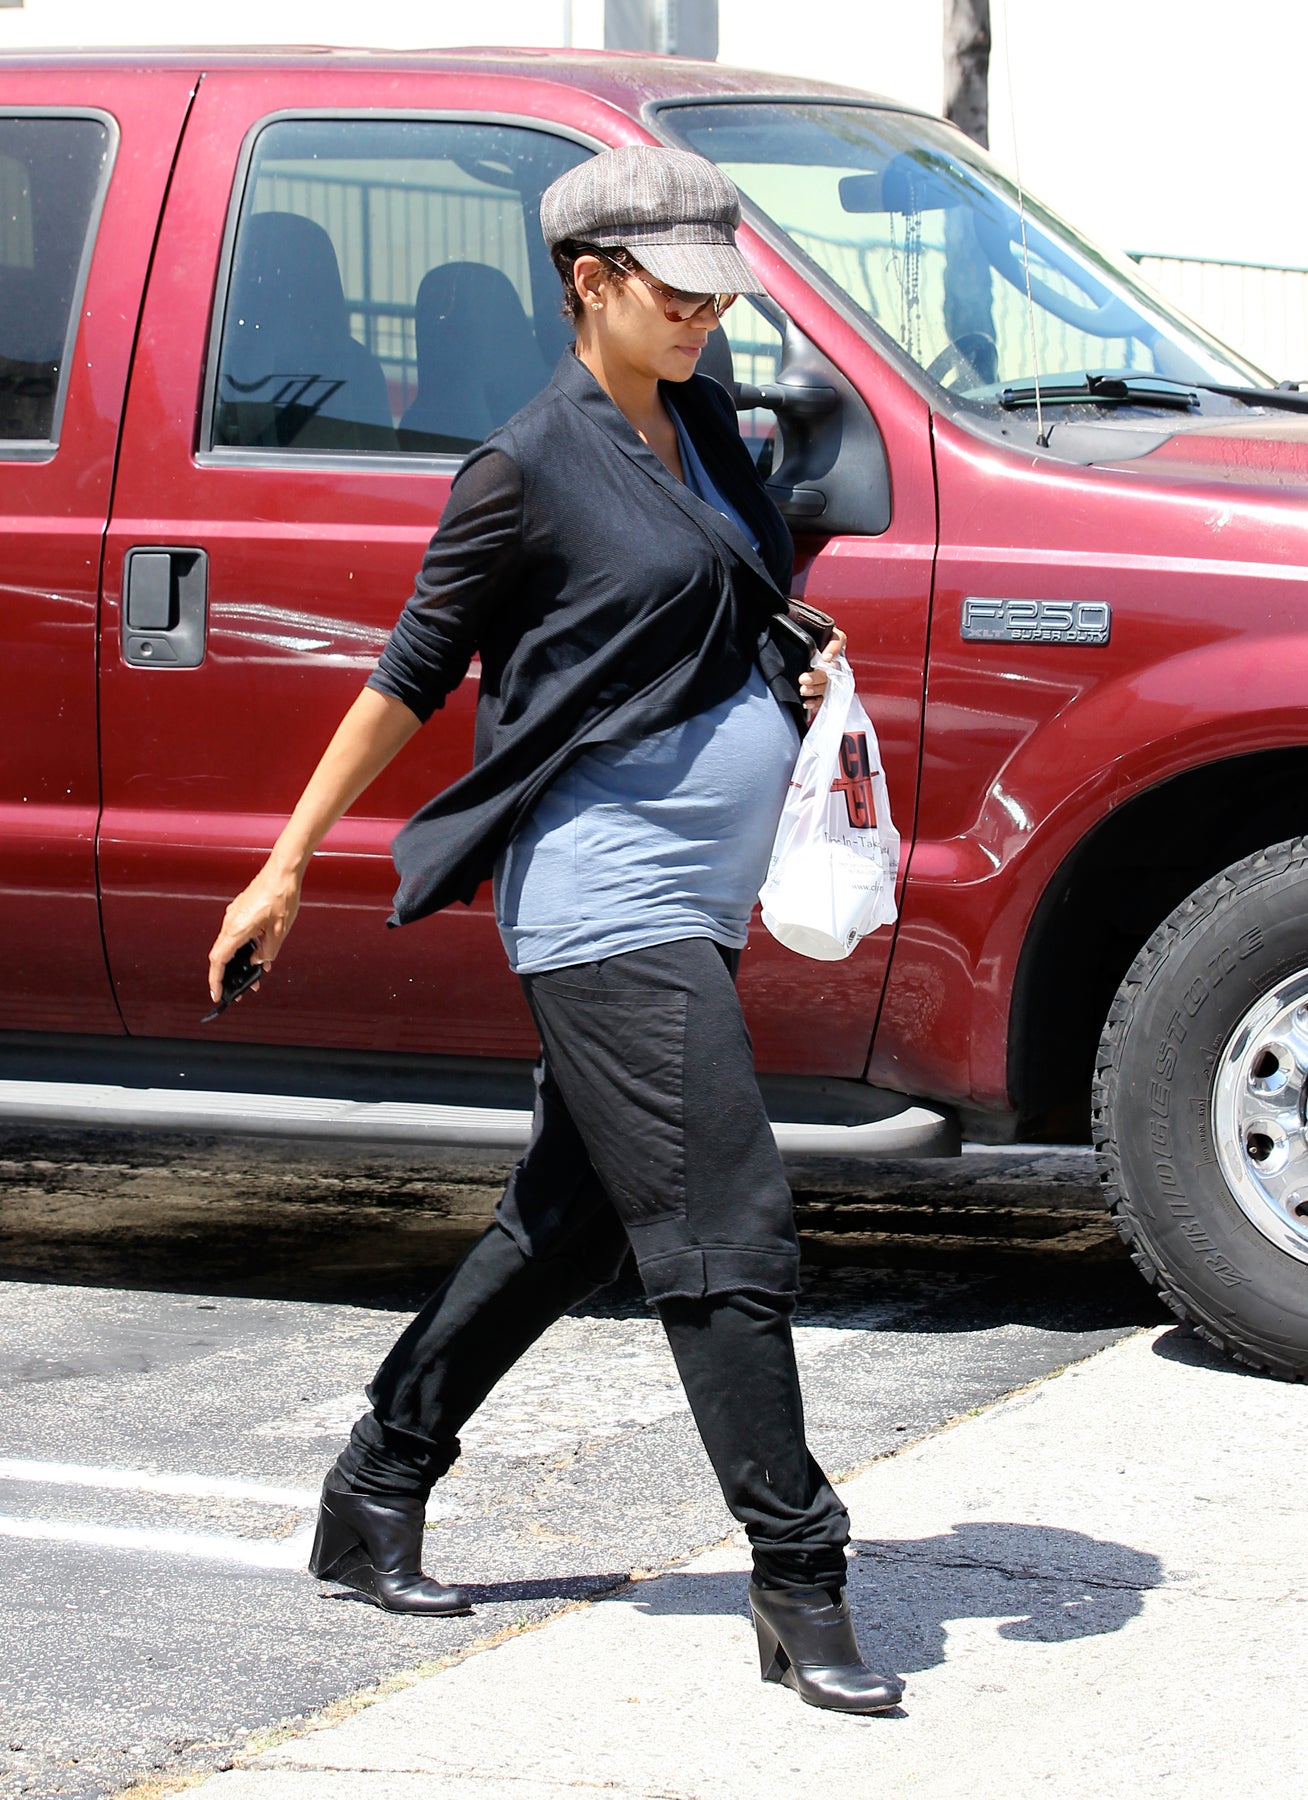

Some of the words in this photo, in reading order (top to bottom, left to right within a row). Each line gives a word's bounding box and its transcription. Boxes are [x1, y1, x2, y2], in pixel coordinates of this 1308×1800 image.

[962, 599, 1109, 632] F-250
[968, 629, 1004, 638] XLT
[1011, 629, 1061, 641] SUPER
[1066, 631, 1108, 642] DUTY
[1148, 925, 1265, 1288] BRIDGESTONE
